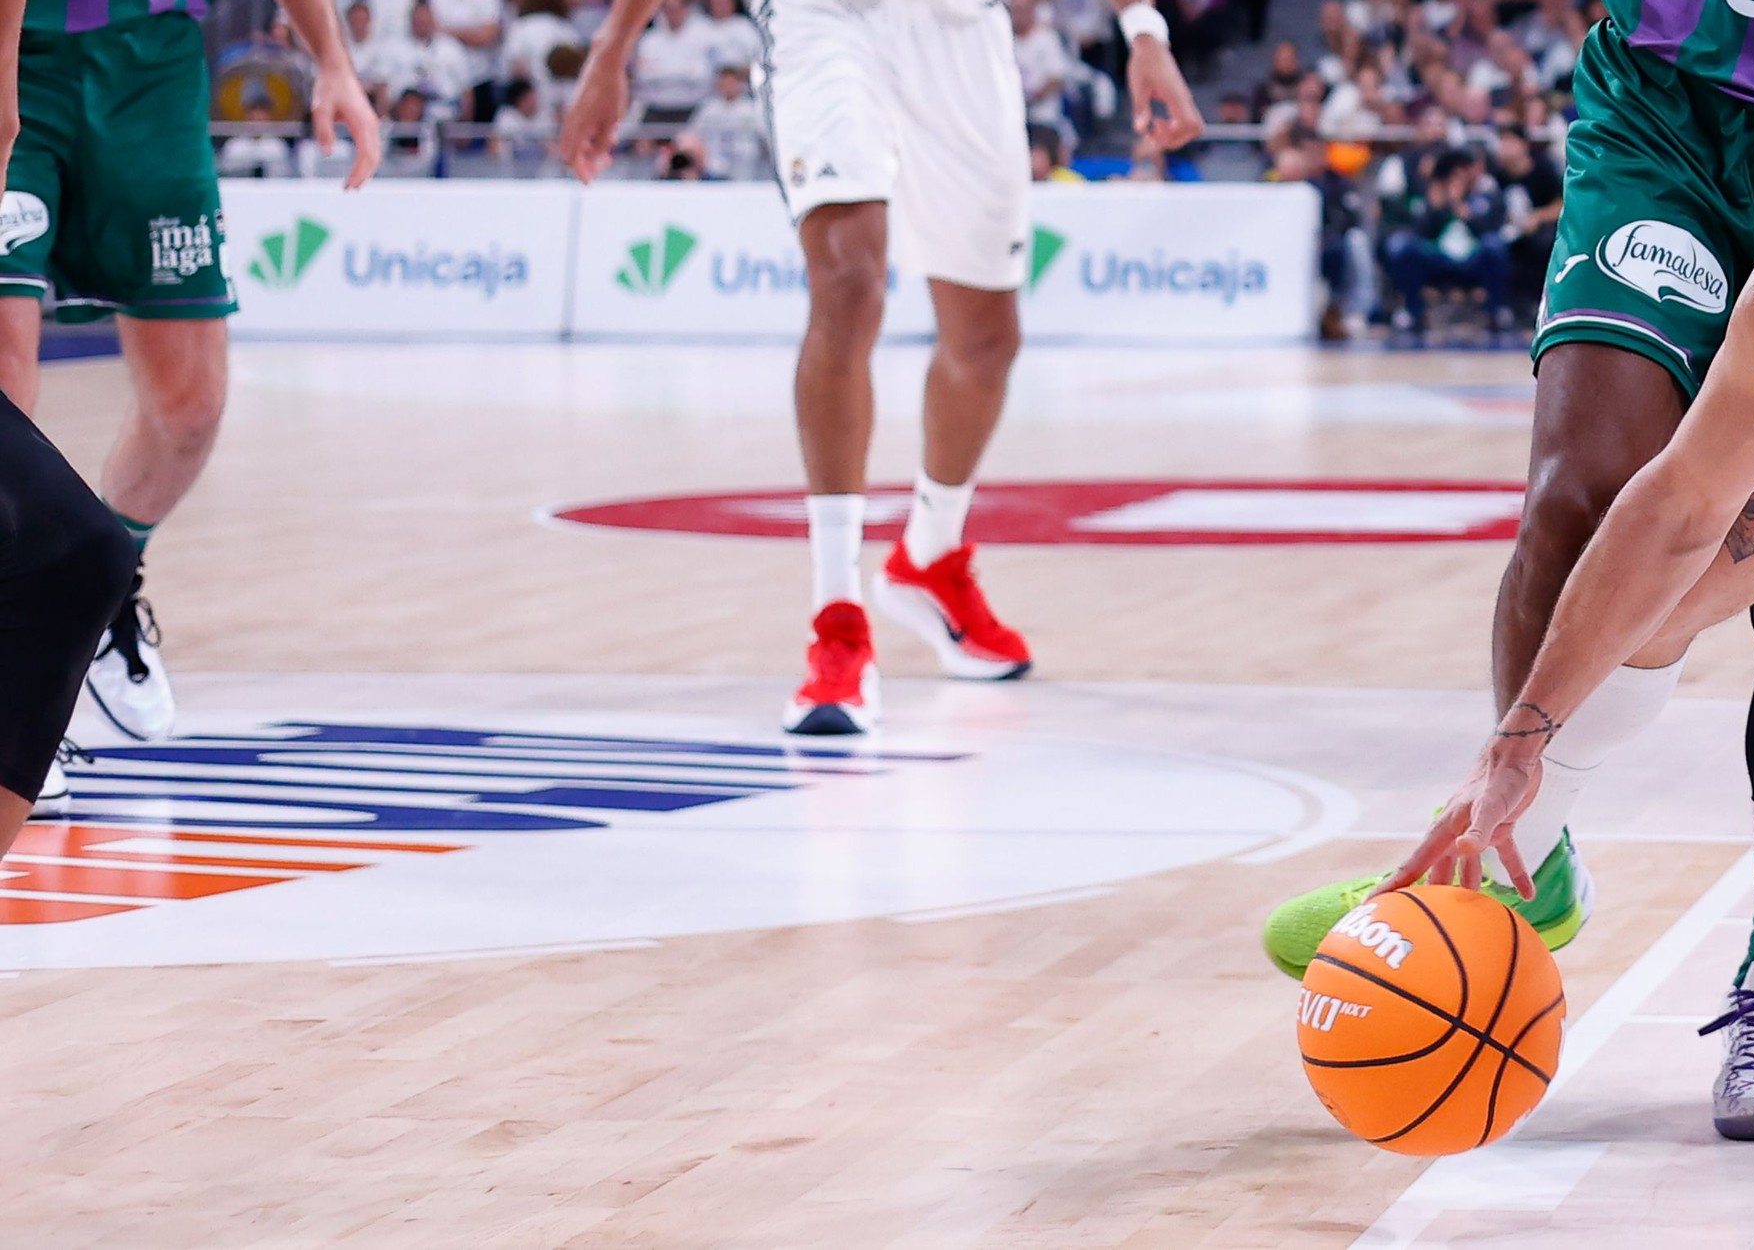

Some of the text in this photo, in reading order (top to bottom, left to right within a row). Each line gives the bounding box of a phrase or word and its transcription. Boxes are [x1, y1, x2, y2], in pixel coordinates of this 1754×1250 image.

[343, 242, 529, 297] Unicaja
[1080, 247, 1269, 303] Unicaja
[1612, 224, 1723, 300] famadesa
[1339, 1002, 1373, 1018] NXT
